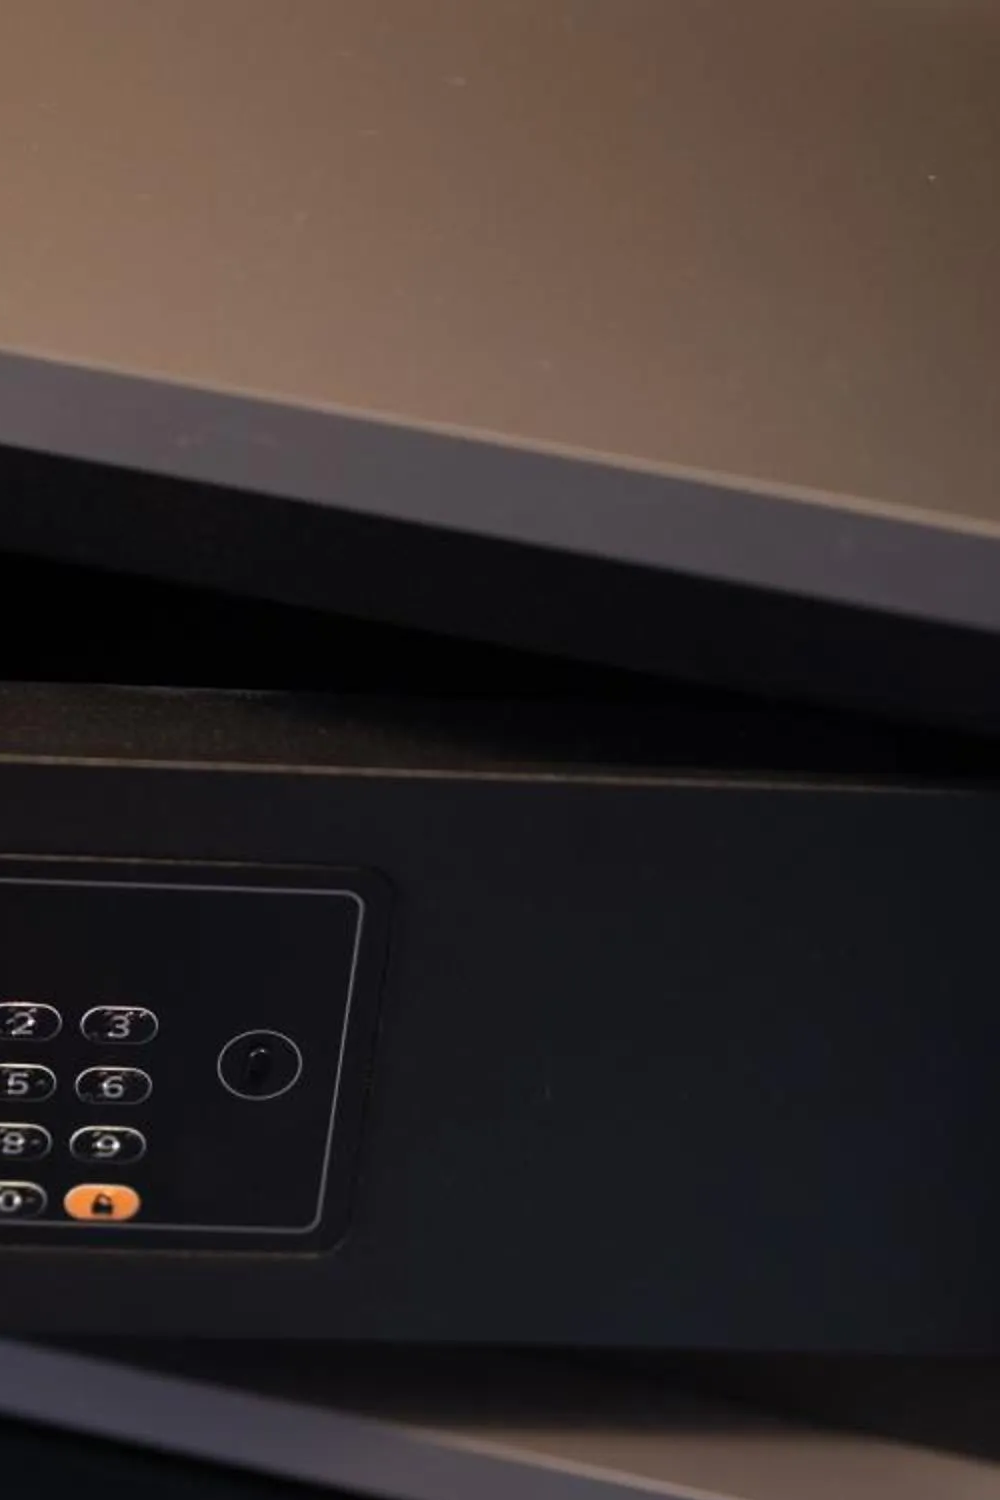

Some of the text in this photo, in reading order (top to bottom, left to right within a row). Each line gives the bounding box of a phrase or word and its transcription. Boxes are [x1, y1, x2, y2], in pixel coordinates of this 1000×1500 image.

[12, 1011, 35, 1035] 2
[107, 1014, 131, 1038] 3
[7, 1072, 29, 1095] 5
[102, 1075, 124, 1098] 6
[3, 1131, 24, 1154] 8
[96, 1134, 120, 1157] 9
